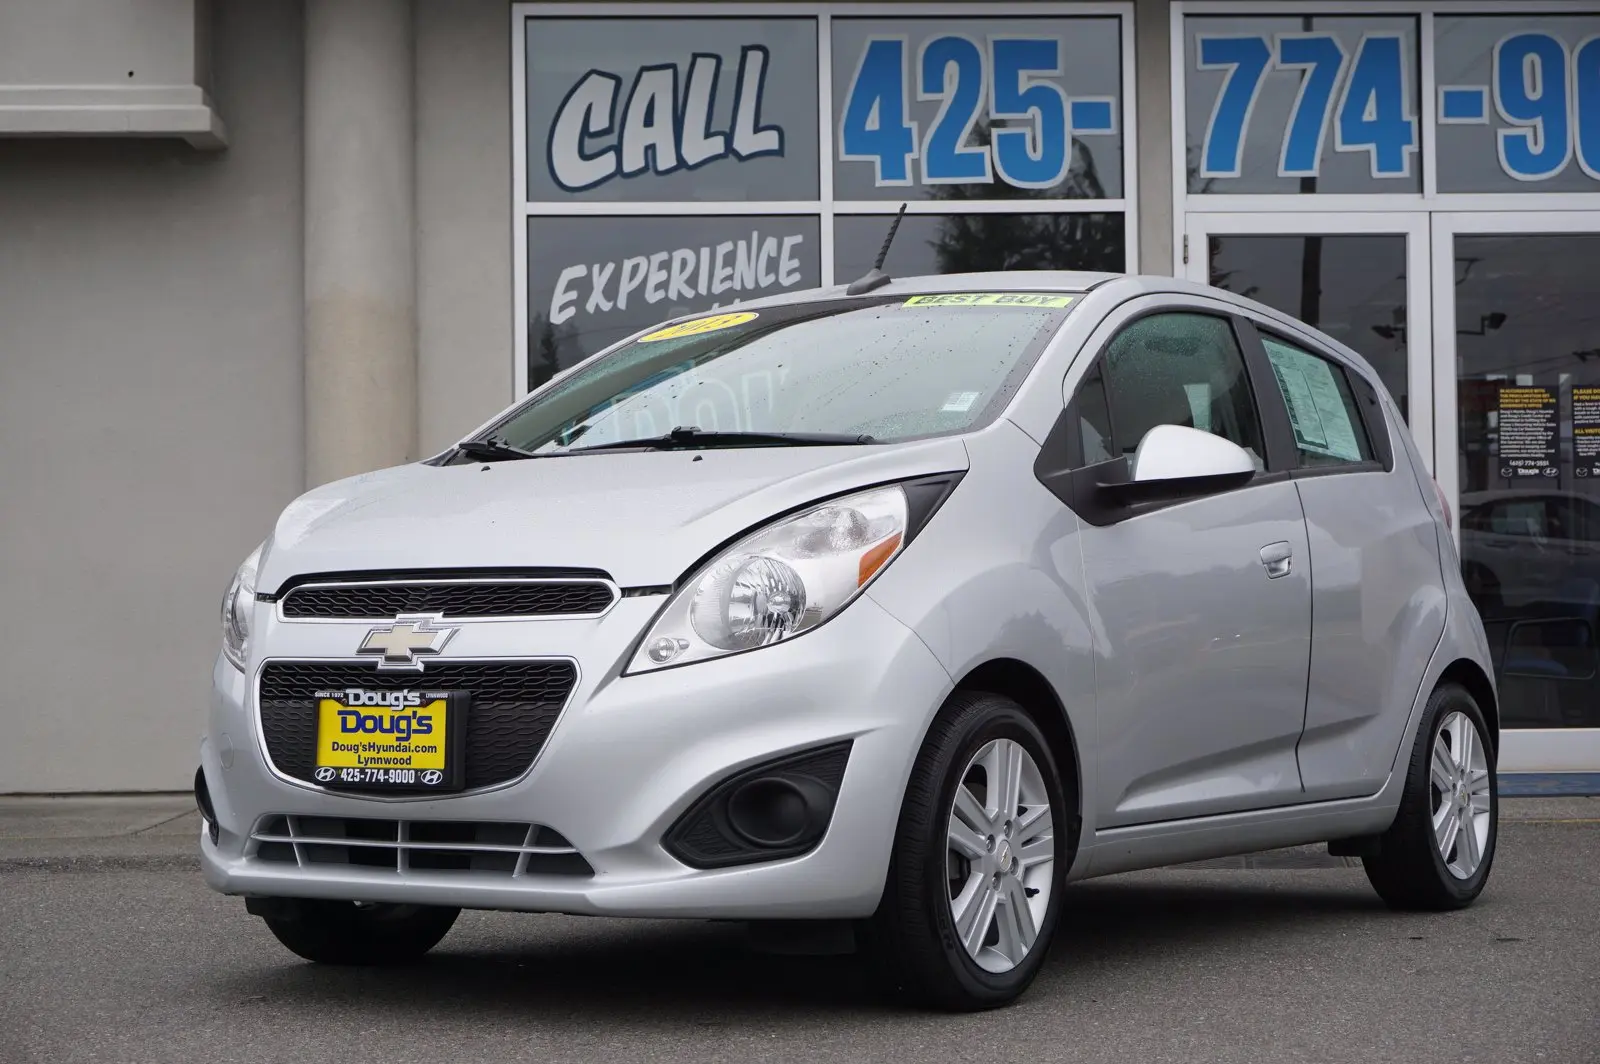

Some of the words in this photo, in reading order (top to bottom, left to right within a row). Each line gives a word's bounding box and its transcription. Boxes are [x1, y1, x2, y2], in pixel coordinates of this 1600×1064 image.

[548, 44, 784, 193] CALL
[839, 33, 1117, 190] 425-
[549, 230, 804, 325] EXPERIENCE
[912, 295, 992, 305] BEST
[993, 295, 1062, 305] BUY
[345, 688, 421, 711] Doug's
[337, 710, 433, 742] Doug's
[332, 742, 437, 754] Doug'sHyundai.com
[357, 754, 412, 766] Lynnwood
[340, 768, 415, 784] 425-774-9000
